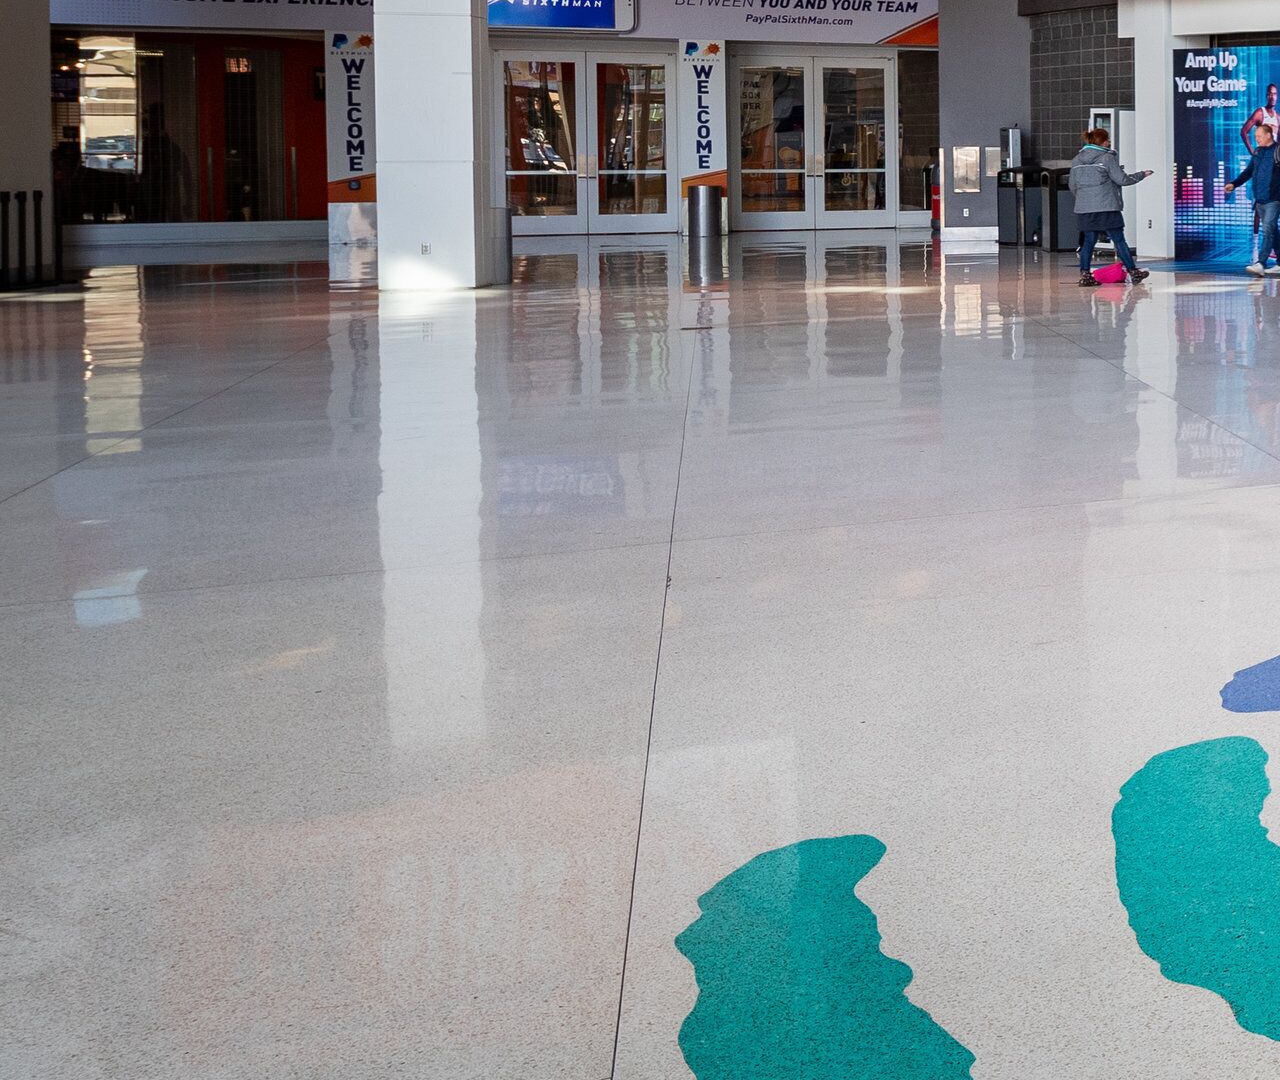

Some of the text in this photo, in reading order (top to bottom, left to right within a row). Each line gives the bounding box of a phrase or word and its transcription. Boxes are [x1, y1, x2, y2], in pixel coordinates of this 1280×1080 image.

[876, 0, 919, 14] TEAM
[745, 13, 853, 26] PayPalSixthMan.com
[1185, 51, 1238, 71] Amp Up
[1175, 75, 1247, 93] Your Game
[341, 58, 365, 172] WELCOME
[693, 65, 714, 169] WELCOME
